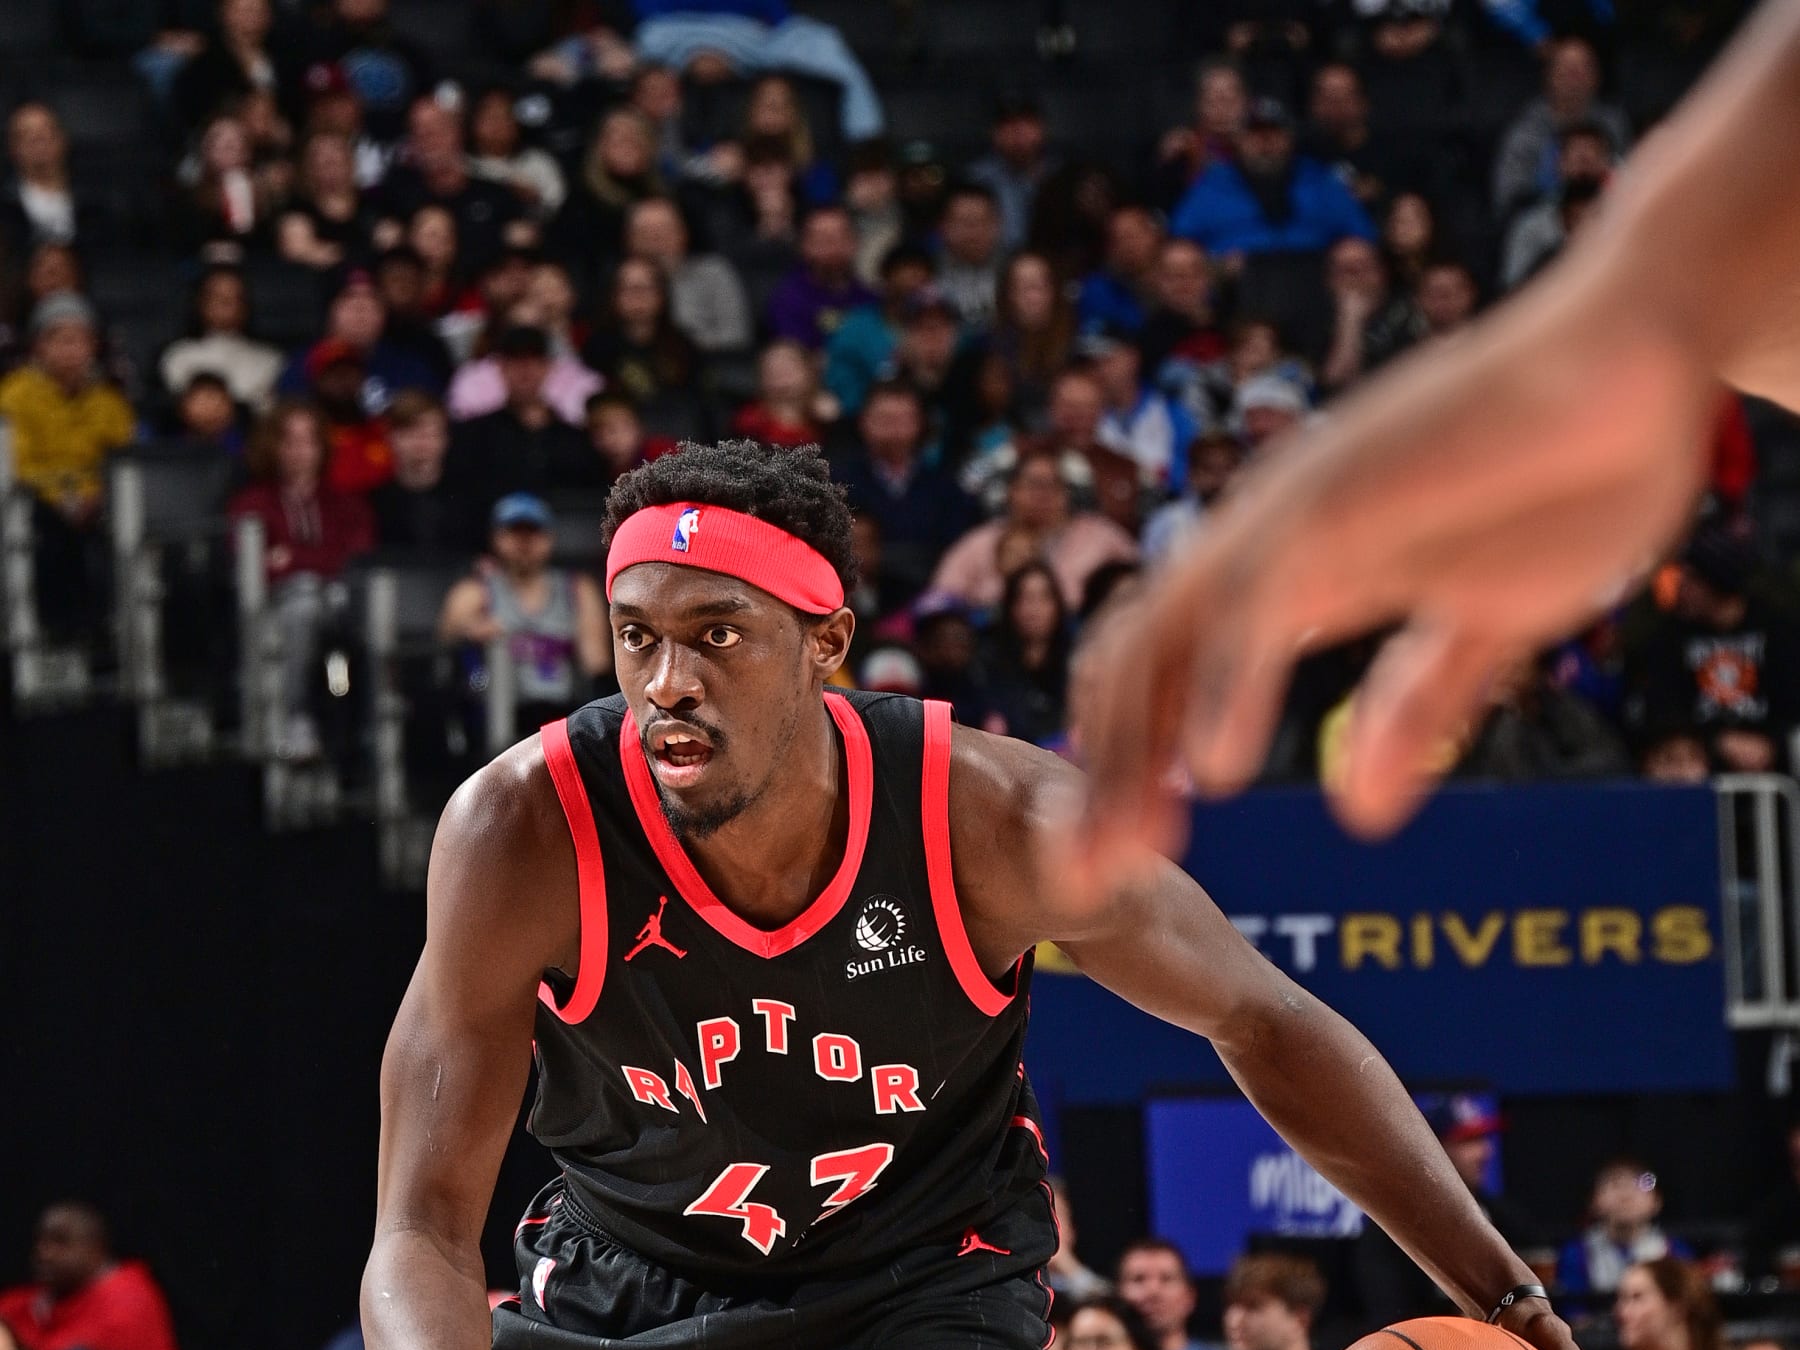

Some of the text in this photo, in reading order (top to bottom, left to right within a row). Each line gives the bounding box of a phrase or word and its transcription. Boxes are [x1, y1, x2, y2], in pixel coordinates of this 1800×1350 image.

[846, 945, 926, 979] Sun Life
[621, 998, 946, 1124] RAPTOR
